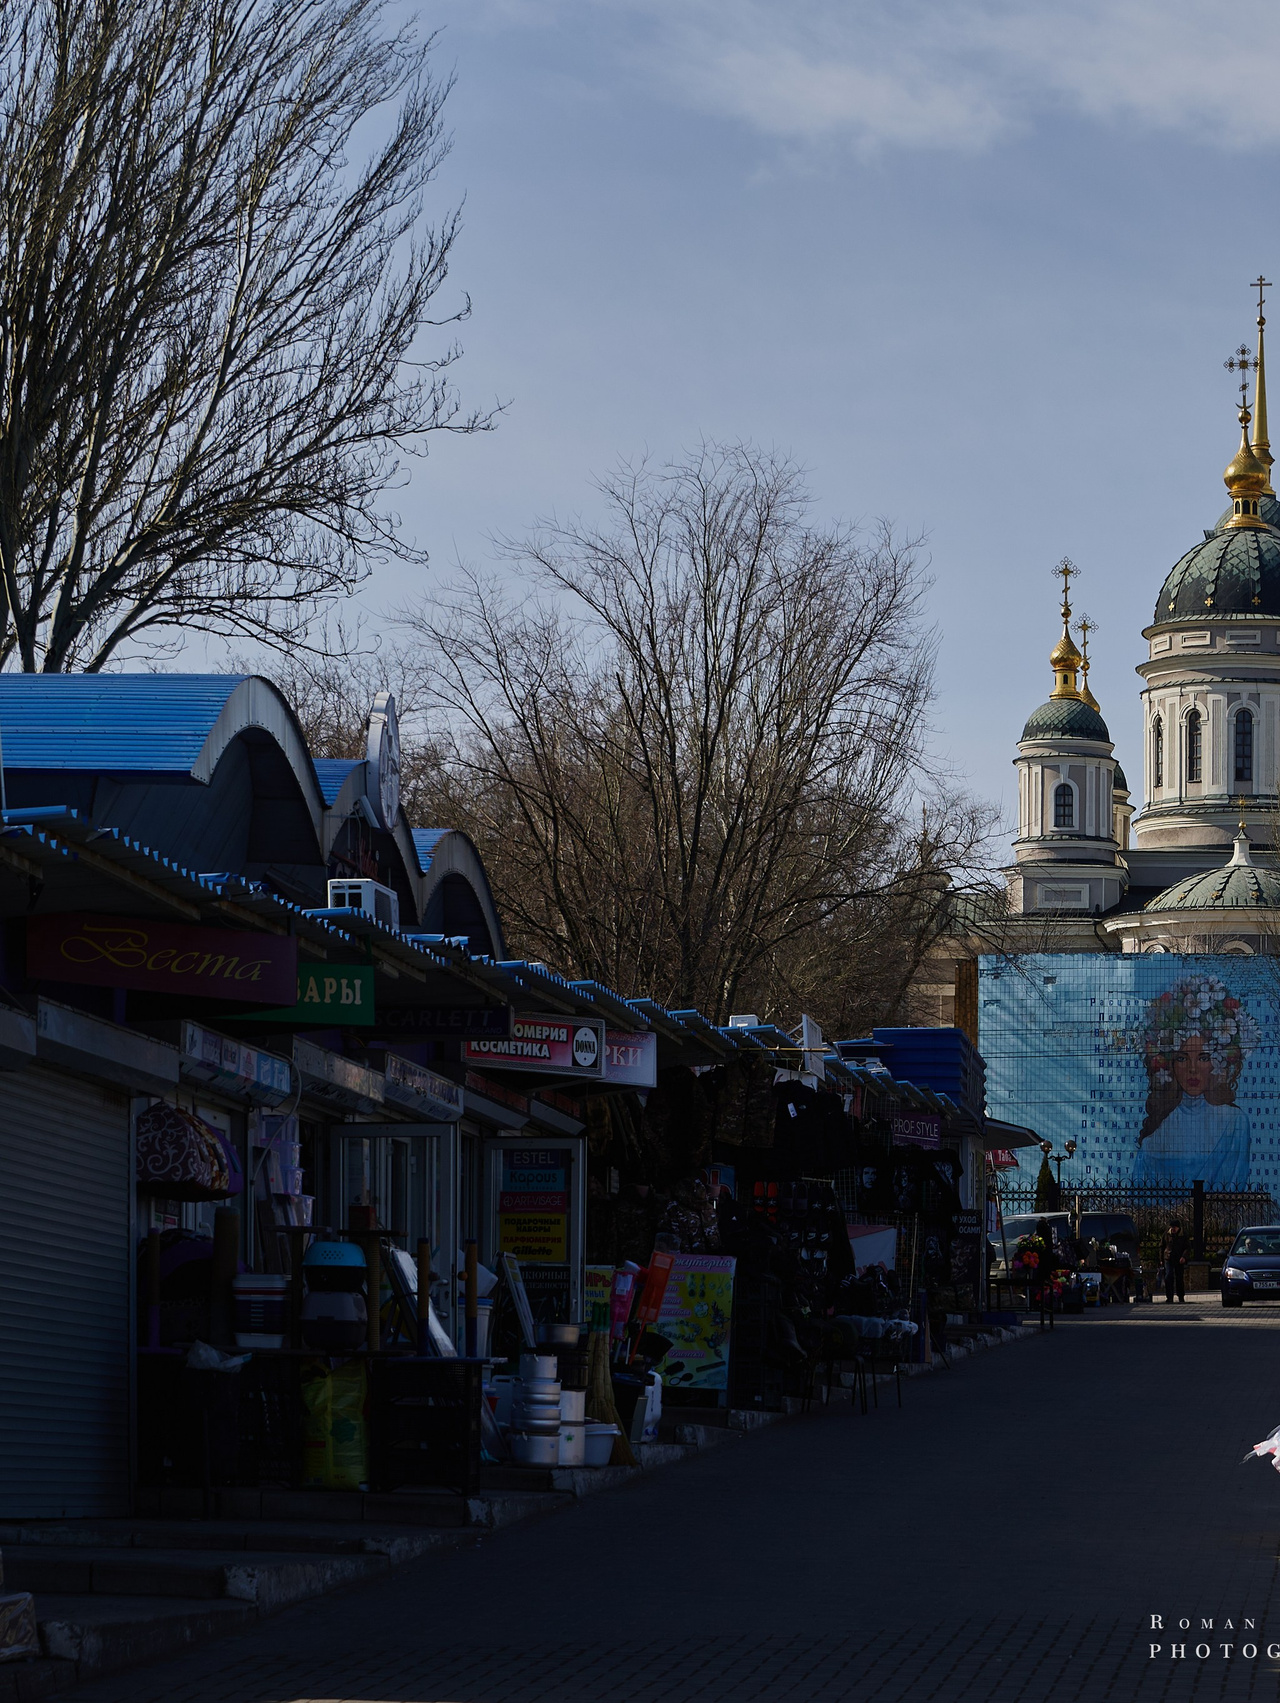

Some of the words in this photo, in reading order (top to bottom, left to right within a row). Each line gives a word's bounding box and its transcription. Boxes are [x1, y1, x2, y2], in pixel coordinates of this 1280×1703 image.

[60, 923, 272, 981] Веста
[297, 975, 362, 1005] АРЫ
[375, 1009, 493, 1027] SCARLETT
[470, 1040, 550, 1058] КОСМЕТИКА
[893, 1118, 915, 1134] PROF
[916, 1120, 939, 1137] STYLE
[513, 1151, 555, 1164] ESTEL
[510, 1170, 558, 1187] Kapous
[504, 1218, 561, 1226] ПОДАРОЧНЫЕ
[959, 1215, 977, 1224] УХОД
[503, 1235, 562, 1243] ПАРФЮМЕРИЯ
[512, 1245, 553, 1255] Gillette
